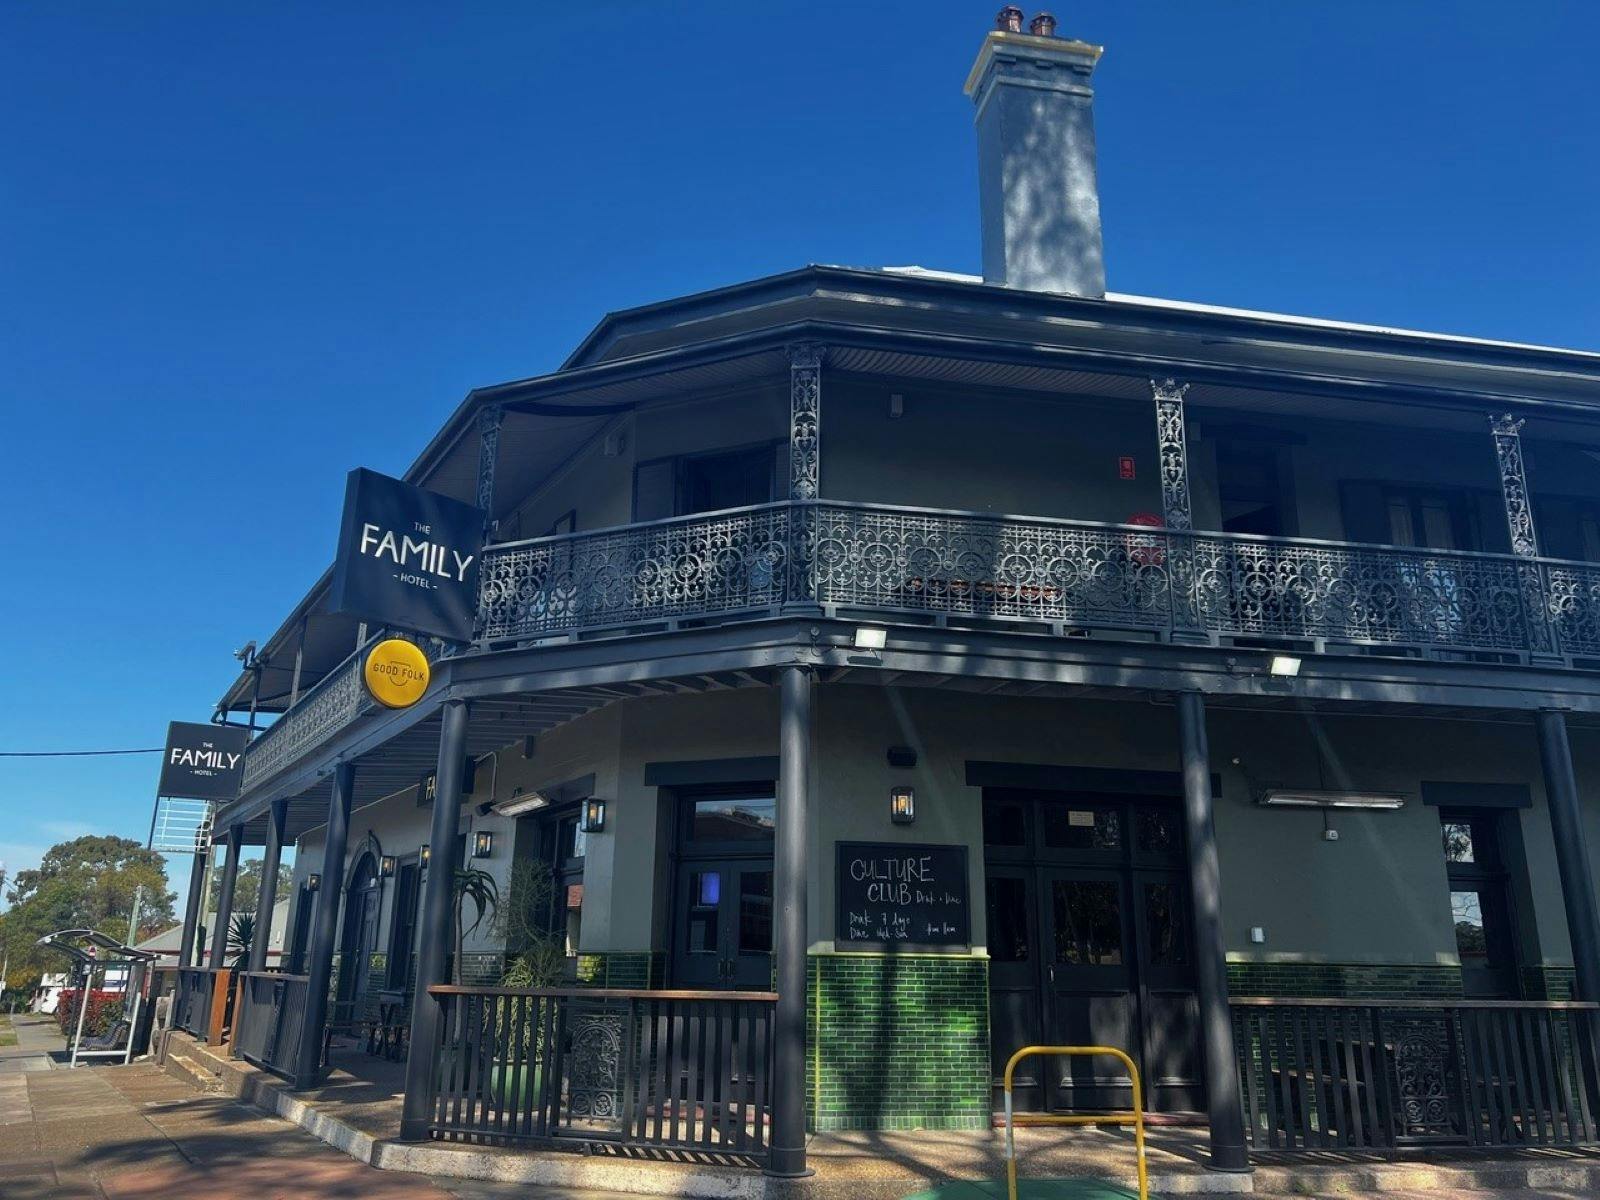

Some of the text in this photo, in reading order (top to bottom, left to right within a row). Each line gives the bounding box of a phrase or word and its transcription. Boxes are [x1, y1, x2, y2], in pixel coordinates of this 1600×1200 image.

[414, 521, 431, 536] THE
[360, 522, 474, 582] FAMILY
[401, 572, 431, 590] HOTEL
[372, 663, 425, 681] GOOD FOLK
[170, 747, 241, 770] FAMILY
[850, 856, 935, 882] CULTURE
[867, 883, 912, 906] CLUB
